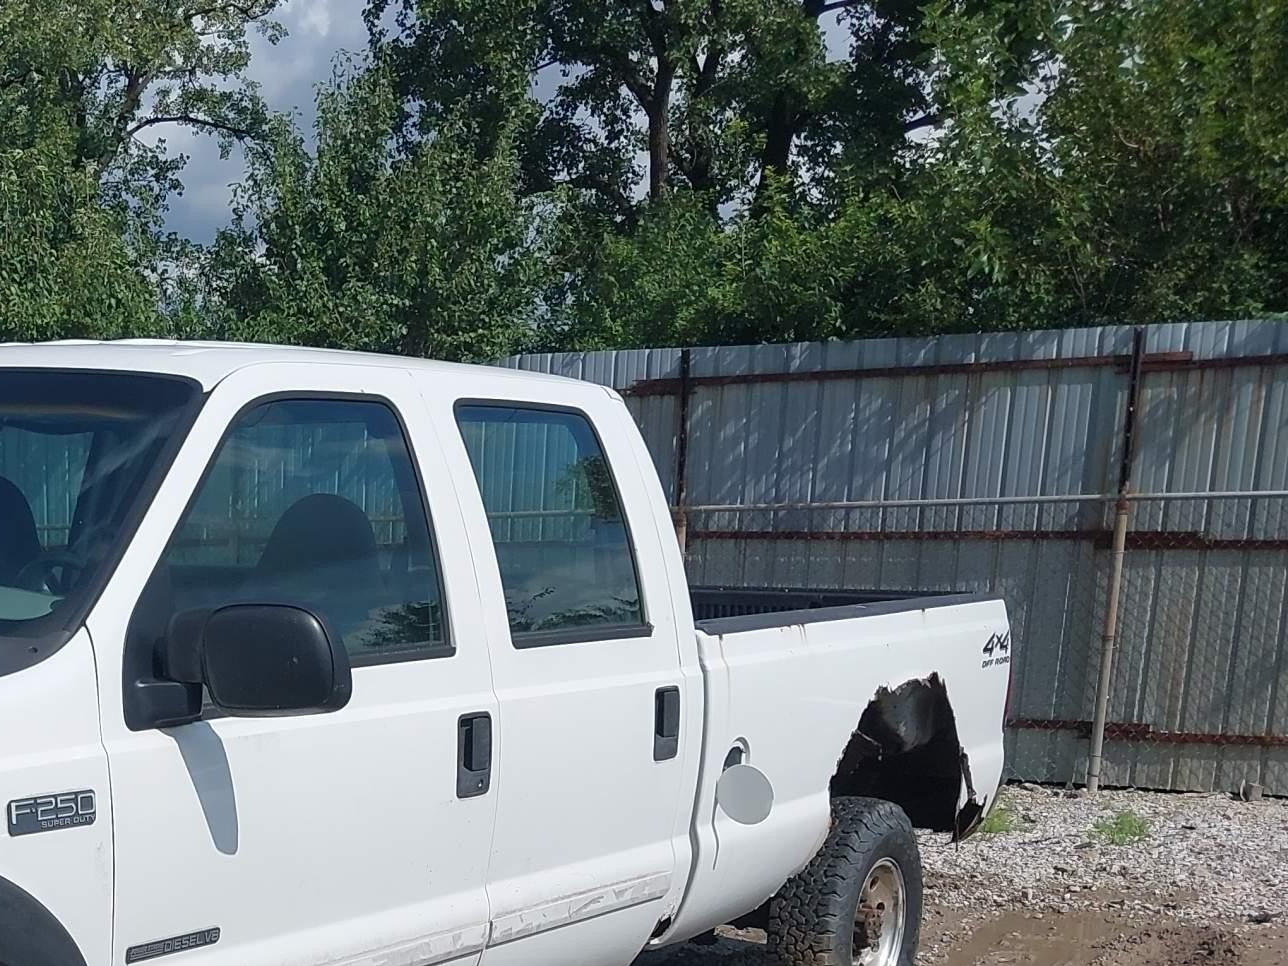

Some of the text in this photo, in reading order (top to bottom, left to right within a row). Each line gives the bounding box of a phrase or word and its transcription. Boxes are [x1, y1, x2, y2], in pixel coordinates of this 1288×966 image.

[41, 814, 96, 829] SUPER DUTY
[164, 933, 203, 953] DIESEL
